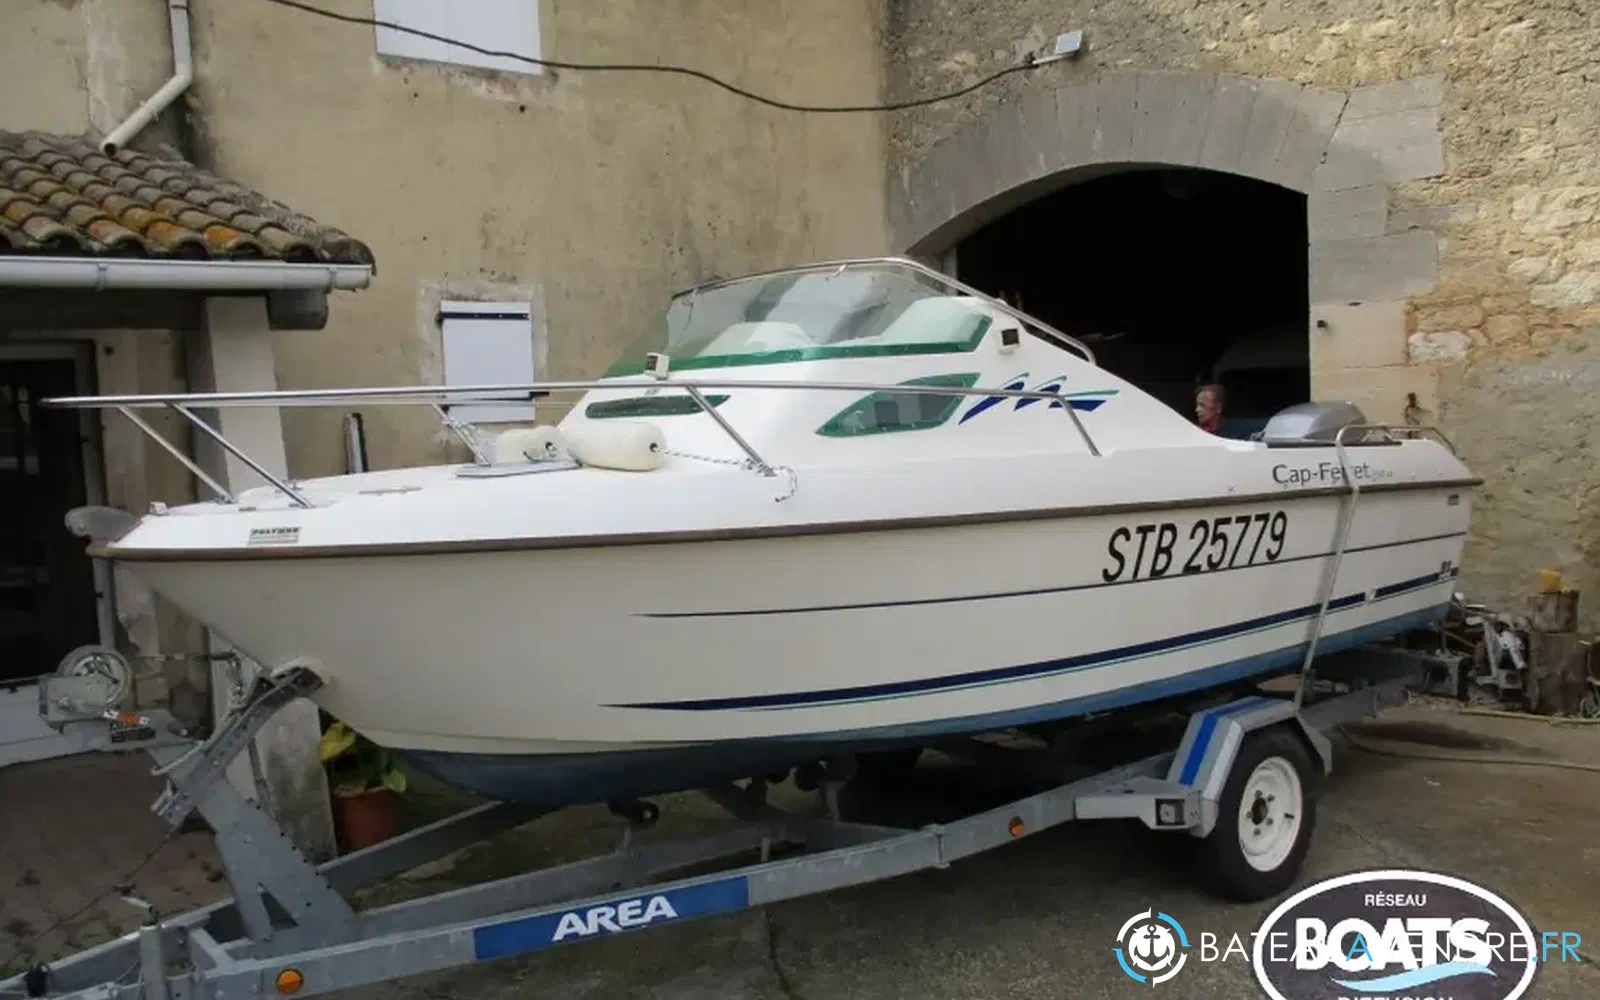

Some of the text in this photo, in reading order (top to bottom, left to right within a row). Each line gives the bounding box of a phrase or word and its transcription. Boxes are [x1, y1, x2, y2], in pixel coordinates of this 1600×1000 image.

[1102, 510, 1288, 582] STB 25779
[552, 895, 679, 941] AREA
